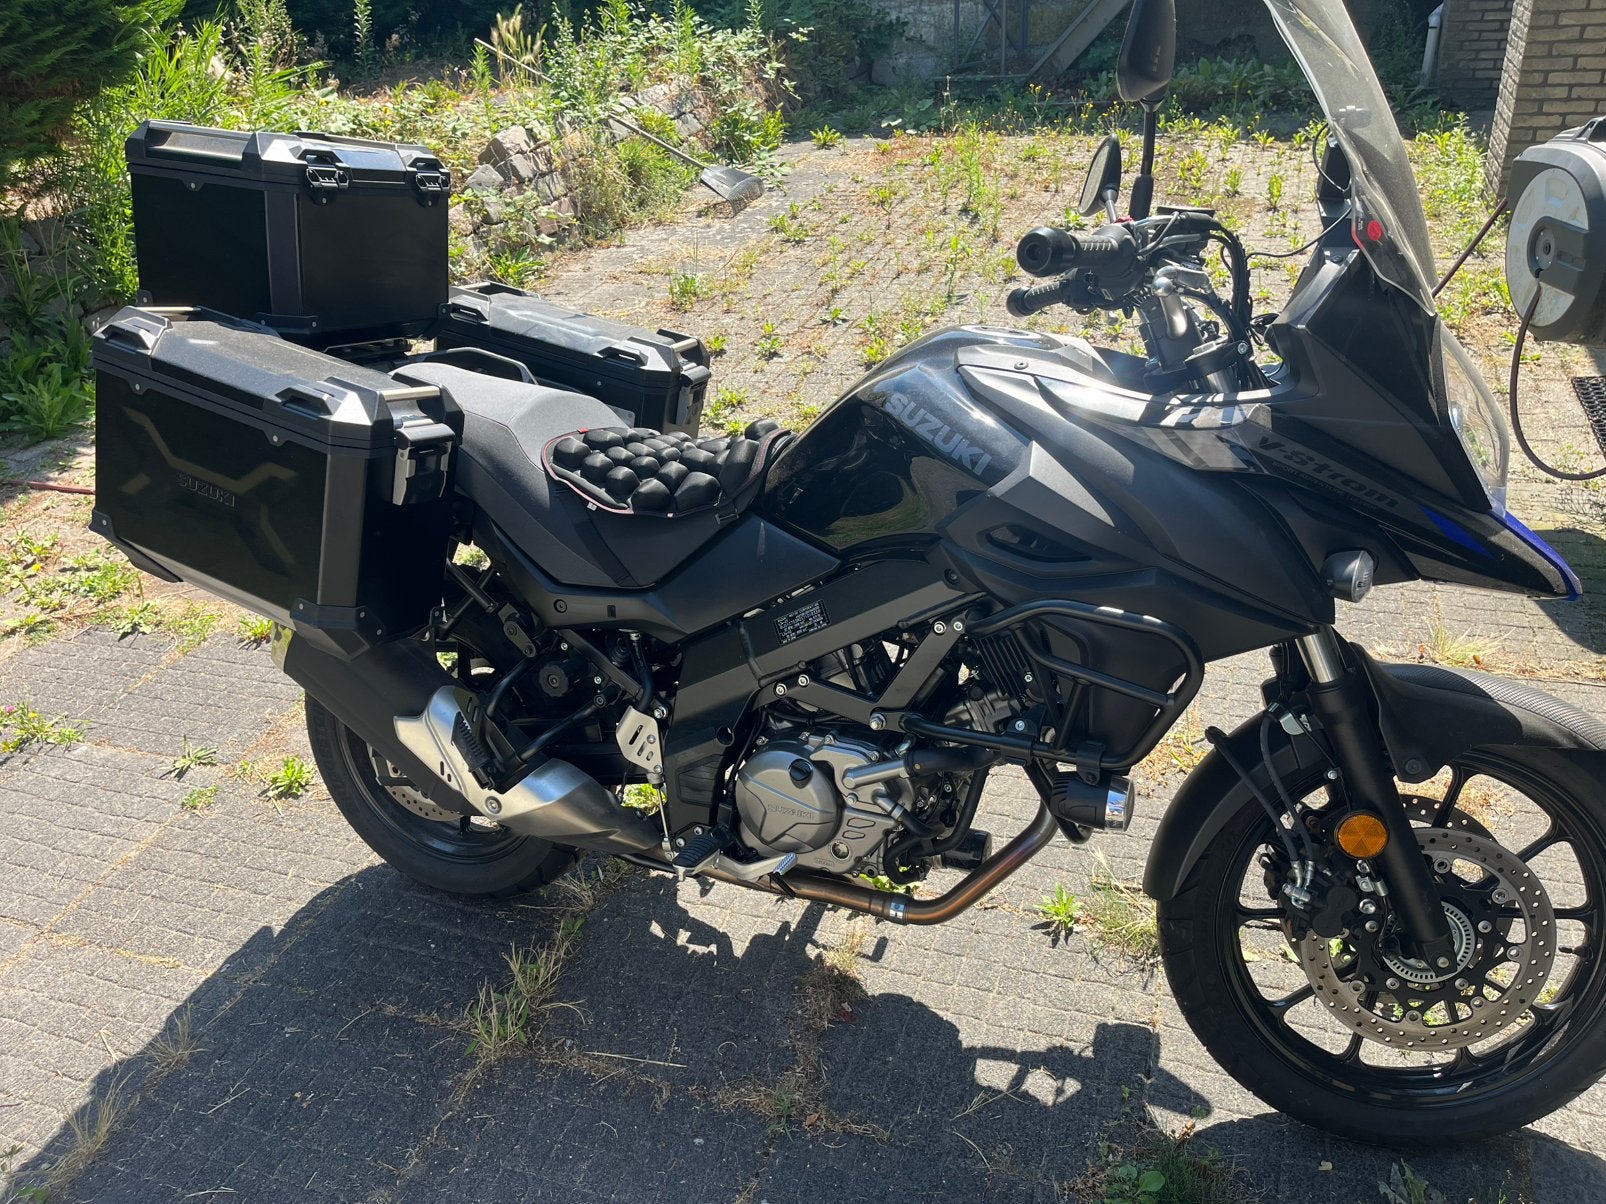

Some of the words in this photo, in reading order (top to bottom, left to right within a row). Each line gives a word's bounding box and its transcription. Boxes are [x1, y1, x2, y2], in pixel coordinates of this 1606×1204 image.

[884, 393, 992, 476] SUZUKI
[176, 472, 235, 508] SUZUKI
[767, 804, 814, 820] SUZUKI
